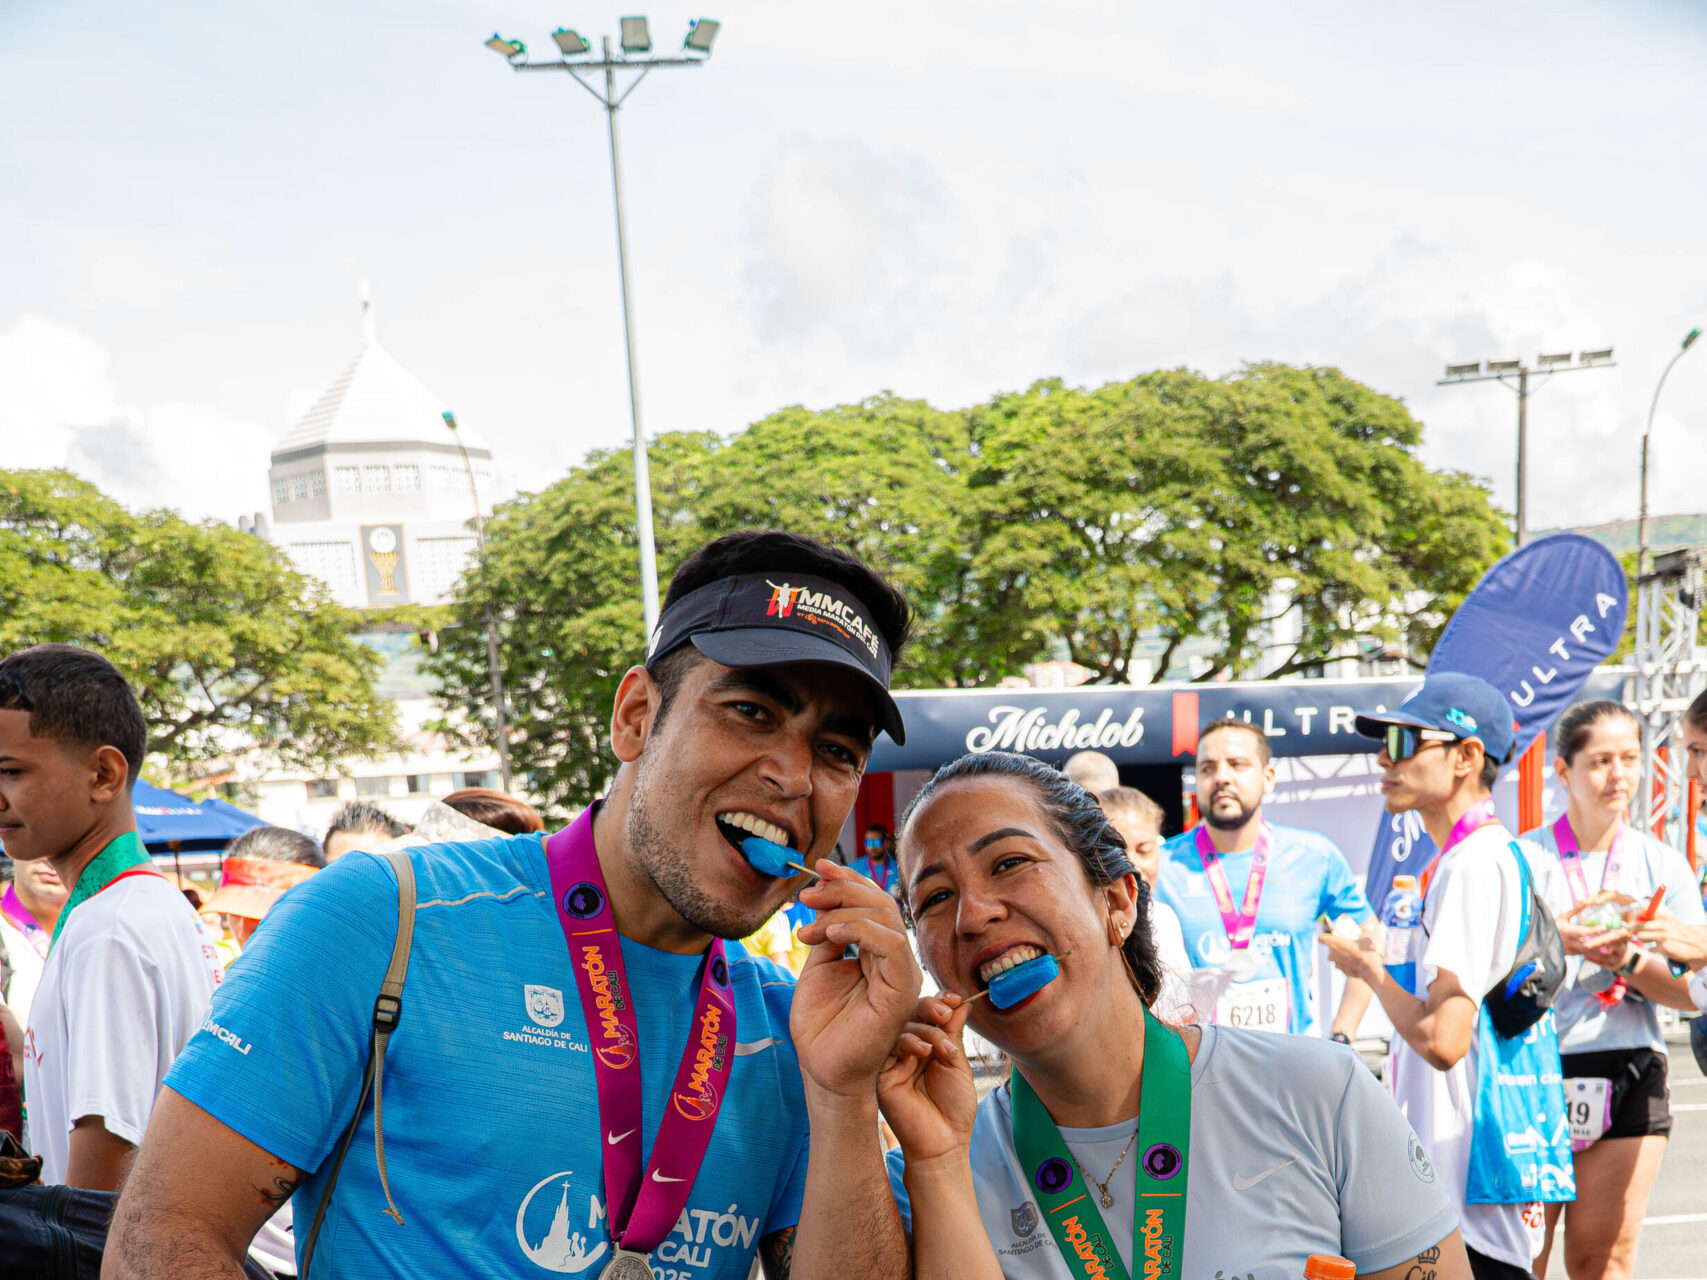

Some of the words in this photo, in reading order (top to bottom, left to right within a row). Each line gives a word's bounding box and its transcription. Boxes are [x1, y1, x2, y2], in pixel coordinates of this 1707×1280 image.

[797, 603, 822, 615] MEDIA
[799, 589, 879, 651] MMCAFÉ
[1510, 593, 1617, 707] ULTRA
[966, 705, 1145, 753] Michelob
[1227, 704, 1387, 737] LTR
[582, 946, 621, 1038] MARATÓN
[606, 970, 622, 995] CALI
[615, 996, 626, 1010] DE
[1230, 1003, 1276, 1027] 6218
[503, 1031, 552, 1046] SANTIAGO
[554, 1039, 567, 1049] DE
[568, 1042, 588, 1053] CALI
[522, 1025, 559, 1038] ALCALDÍA
[560, 1032, 571, 1040] DE
[688, 1004, 722, 1092] MARATÓN
[714, 1034, 728, 1056] CALI
[712, 1055, 723, 1071] DE
[588, 1192, 761, 1250] MATÓN
[657, 1240, 712, 1268] CALI
[998, 1245, 1034, 1256] SANTIAGO
[1089, 1233, 1107, 1256] CALI
[1162, 1235, 1173, 1259] CALI
[1101, 1255, 1114, 1270] DE
[1162, 1260, 1172, 1275] DE
